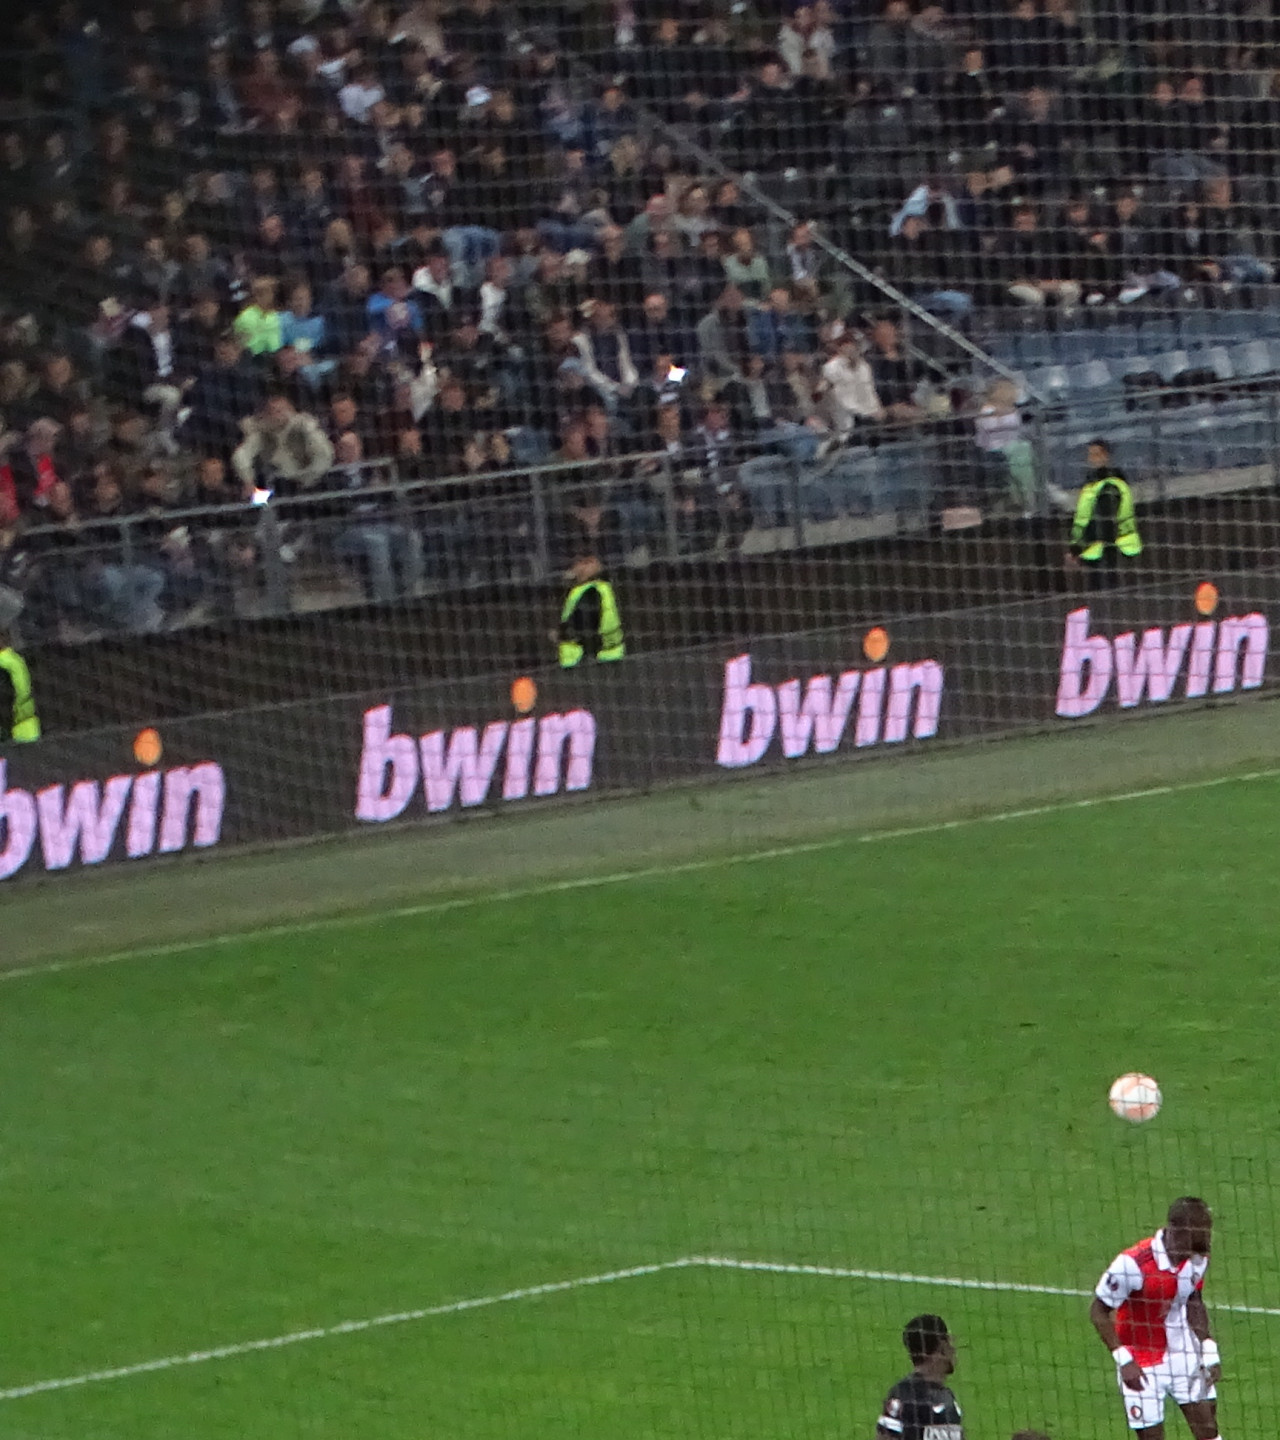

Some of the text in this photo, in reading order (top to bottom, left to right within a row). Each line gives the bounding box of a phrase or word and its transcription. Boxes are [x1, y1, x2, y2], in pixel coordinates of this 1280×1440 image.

[715, 626, 944, 768] bwin
[1054, 581, 1269, 719] bwin
[354, 676, 596, 822] bwin
